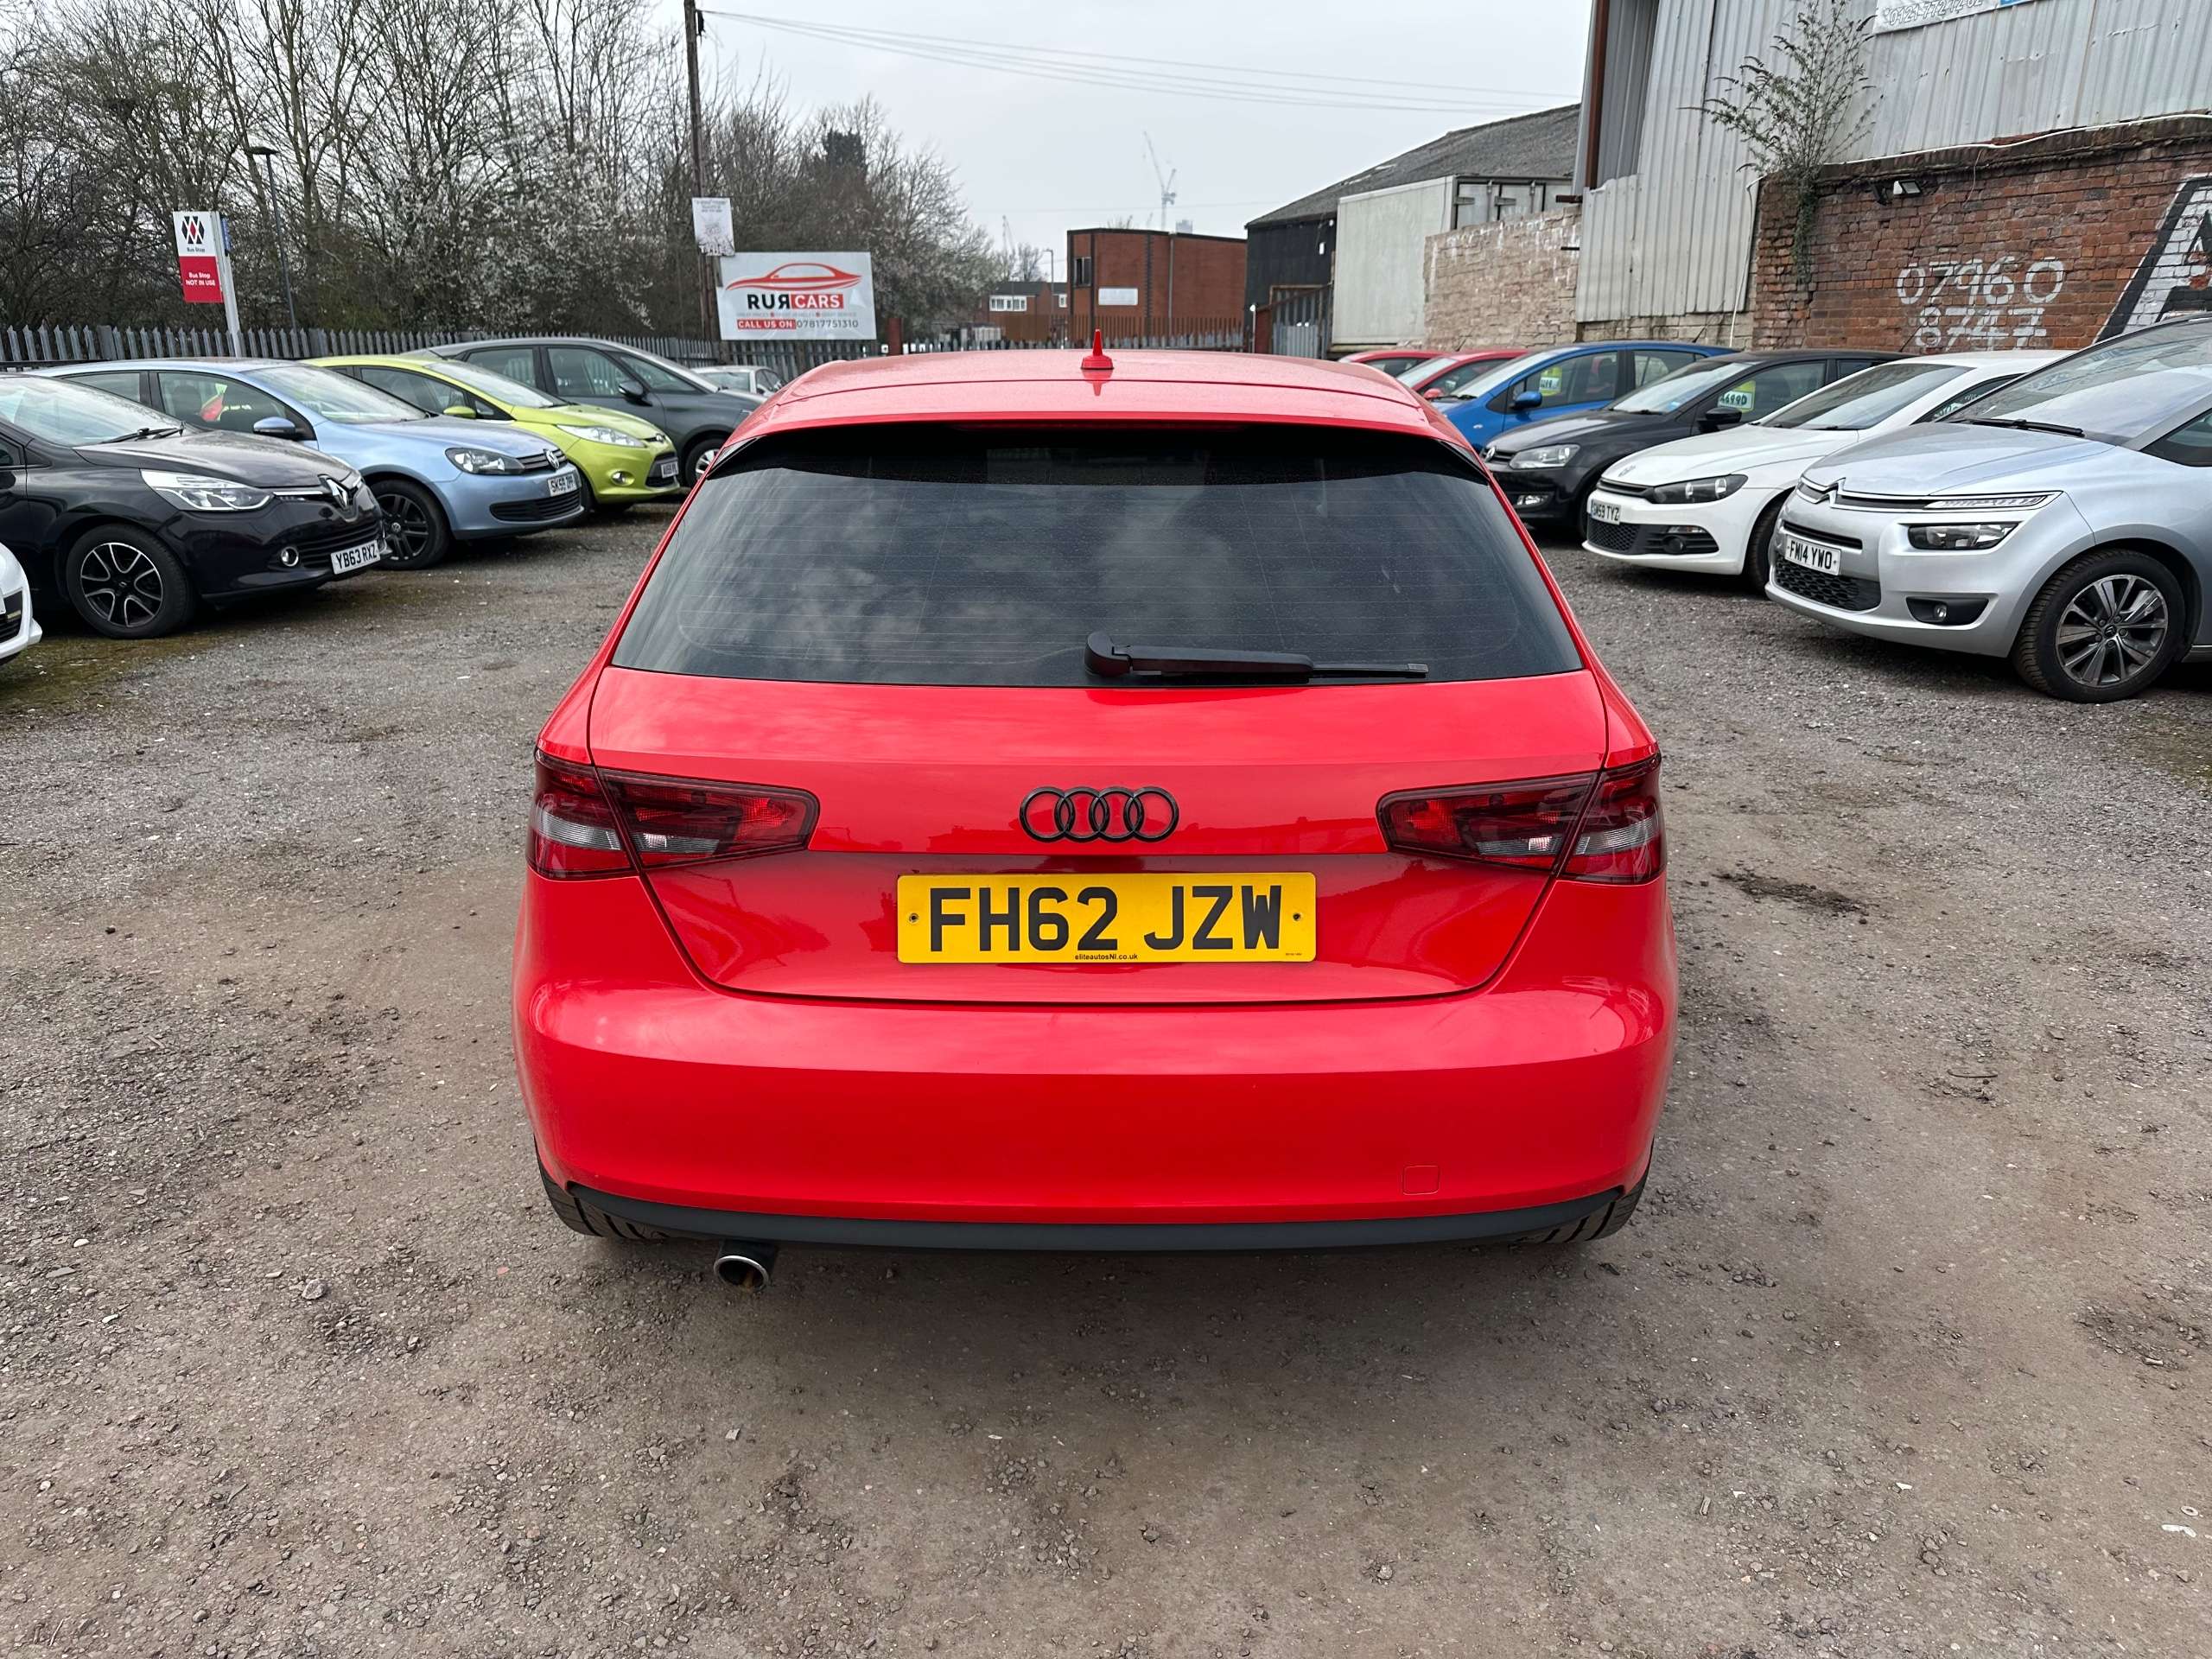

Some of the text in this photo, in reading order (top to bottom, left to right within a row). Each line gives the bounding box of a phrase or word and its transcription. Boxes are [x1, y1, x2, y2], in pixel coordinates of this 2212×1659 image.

[1897, 257, 2065, 305] 07960
[797, 320, 859, 328] 07817751310
[1607, 505, 1619, 521] TYZ
[335, 543, 377, 569] YB63 RXZ
[1789, 540, 1833, 569] FM14 YWO
[930, 885, 1282, 951] FH62 JZW
